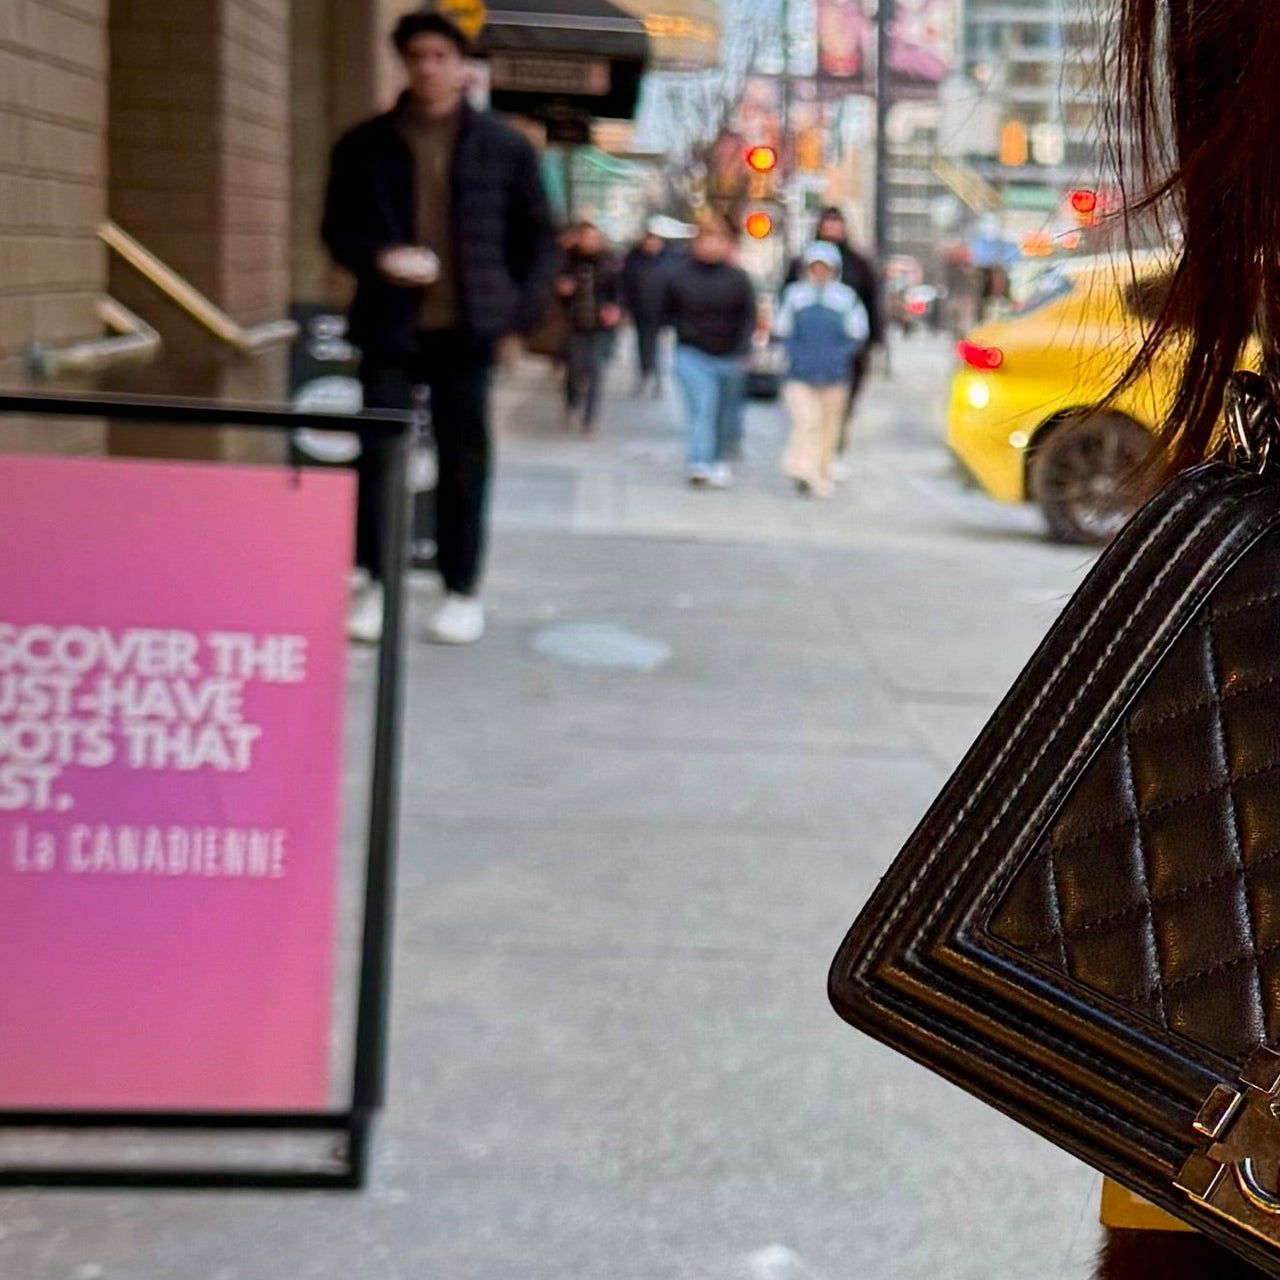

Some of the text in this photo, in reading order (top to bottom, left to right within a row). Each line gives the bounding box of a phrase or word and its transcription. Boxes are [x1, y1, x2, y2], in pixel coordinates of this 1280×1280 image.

[208, 631, 307, 682] THE
[123, 724, 262, 772] THAT
[14, 822, 288, 879] La CANADIENNE
